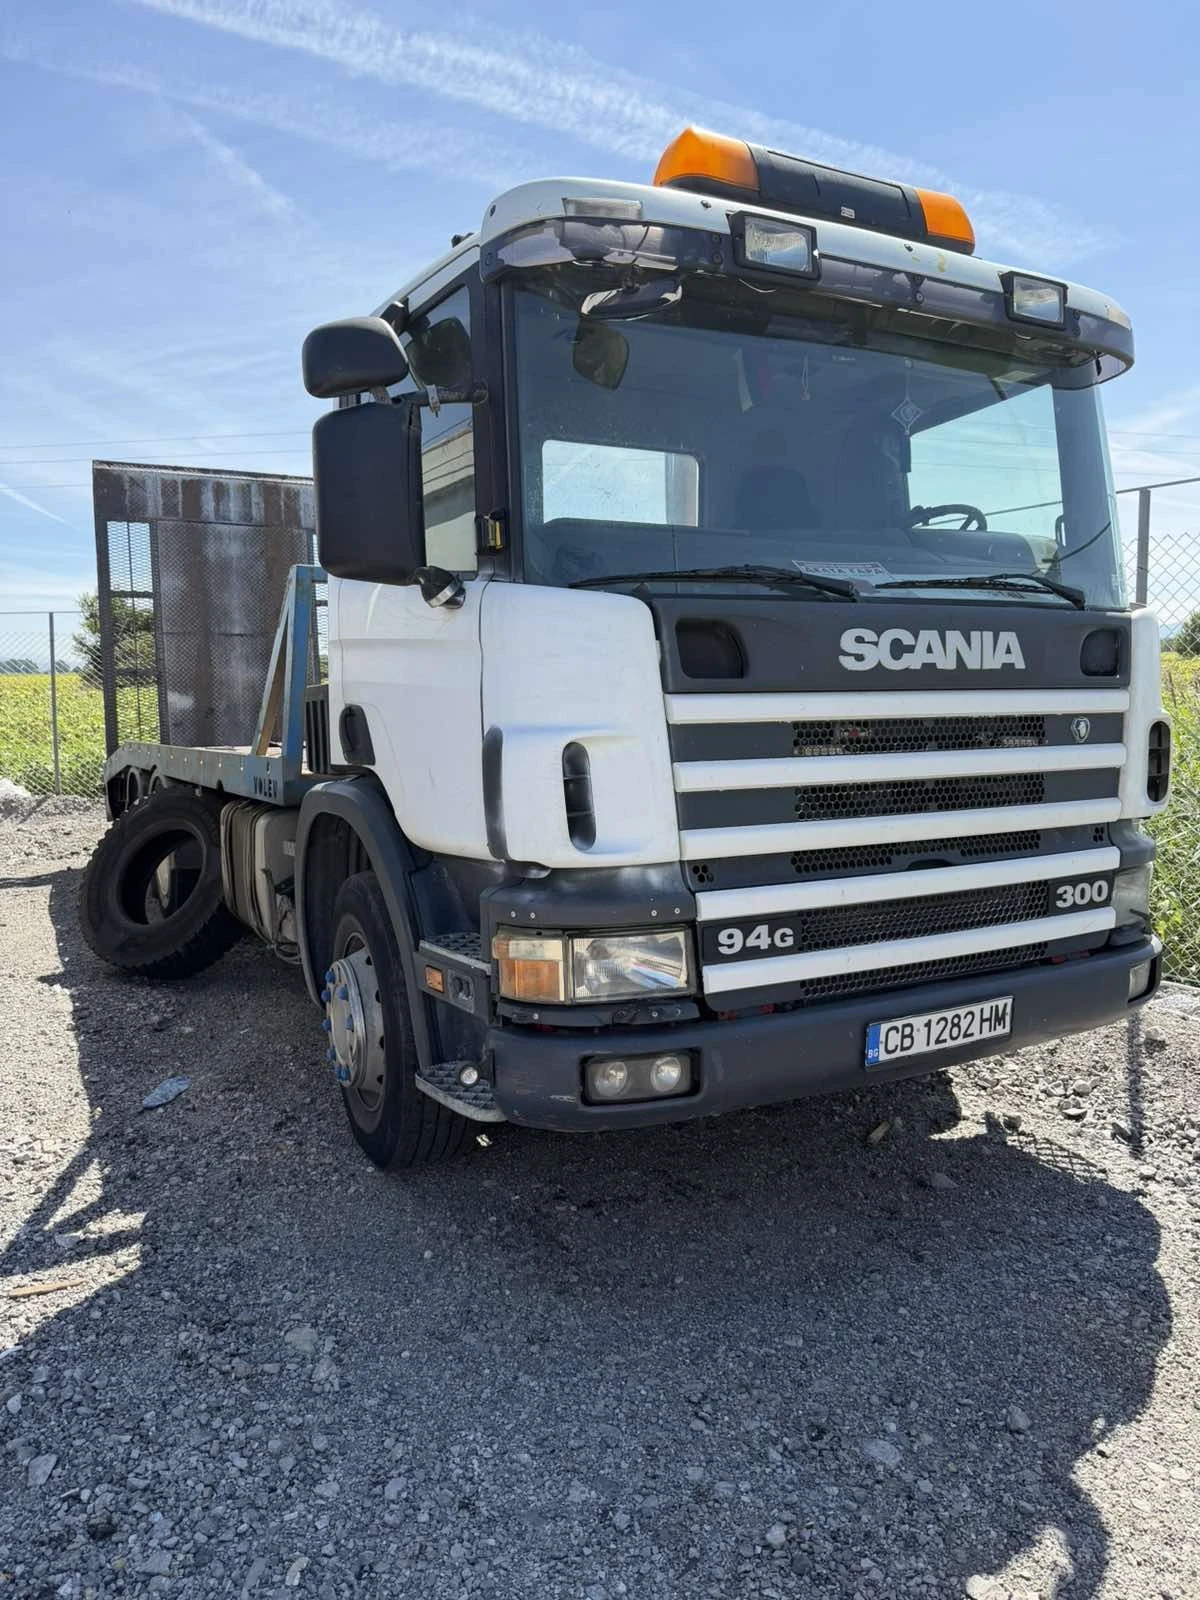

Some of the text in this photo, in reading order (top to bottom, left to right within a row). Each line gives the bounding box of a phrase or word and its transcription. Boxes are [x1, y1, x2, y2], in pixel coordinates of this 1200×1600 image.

[838, 628, 1026, 671] SCANIA
[1055, 880, 1109, 908] 300
[718, 924, 794, 955] 94G
[884, 1002, 1008, 1055] CB 1282 HM
[868, 1049, 879, 1059] BG
